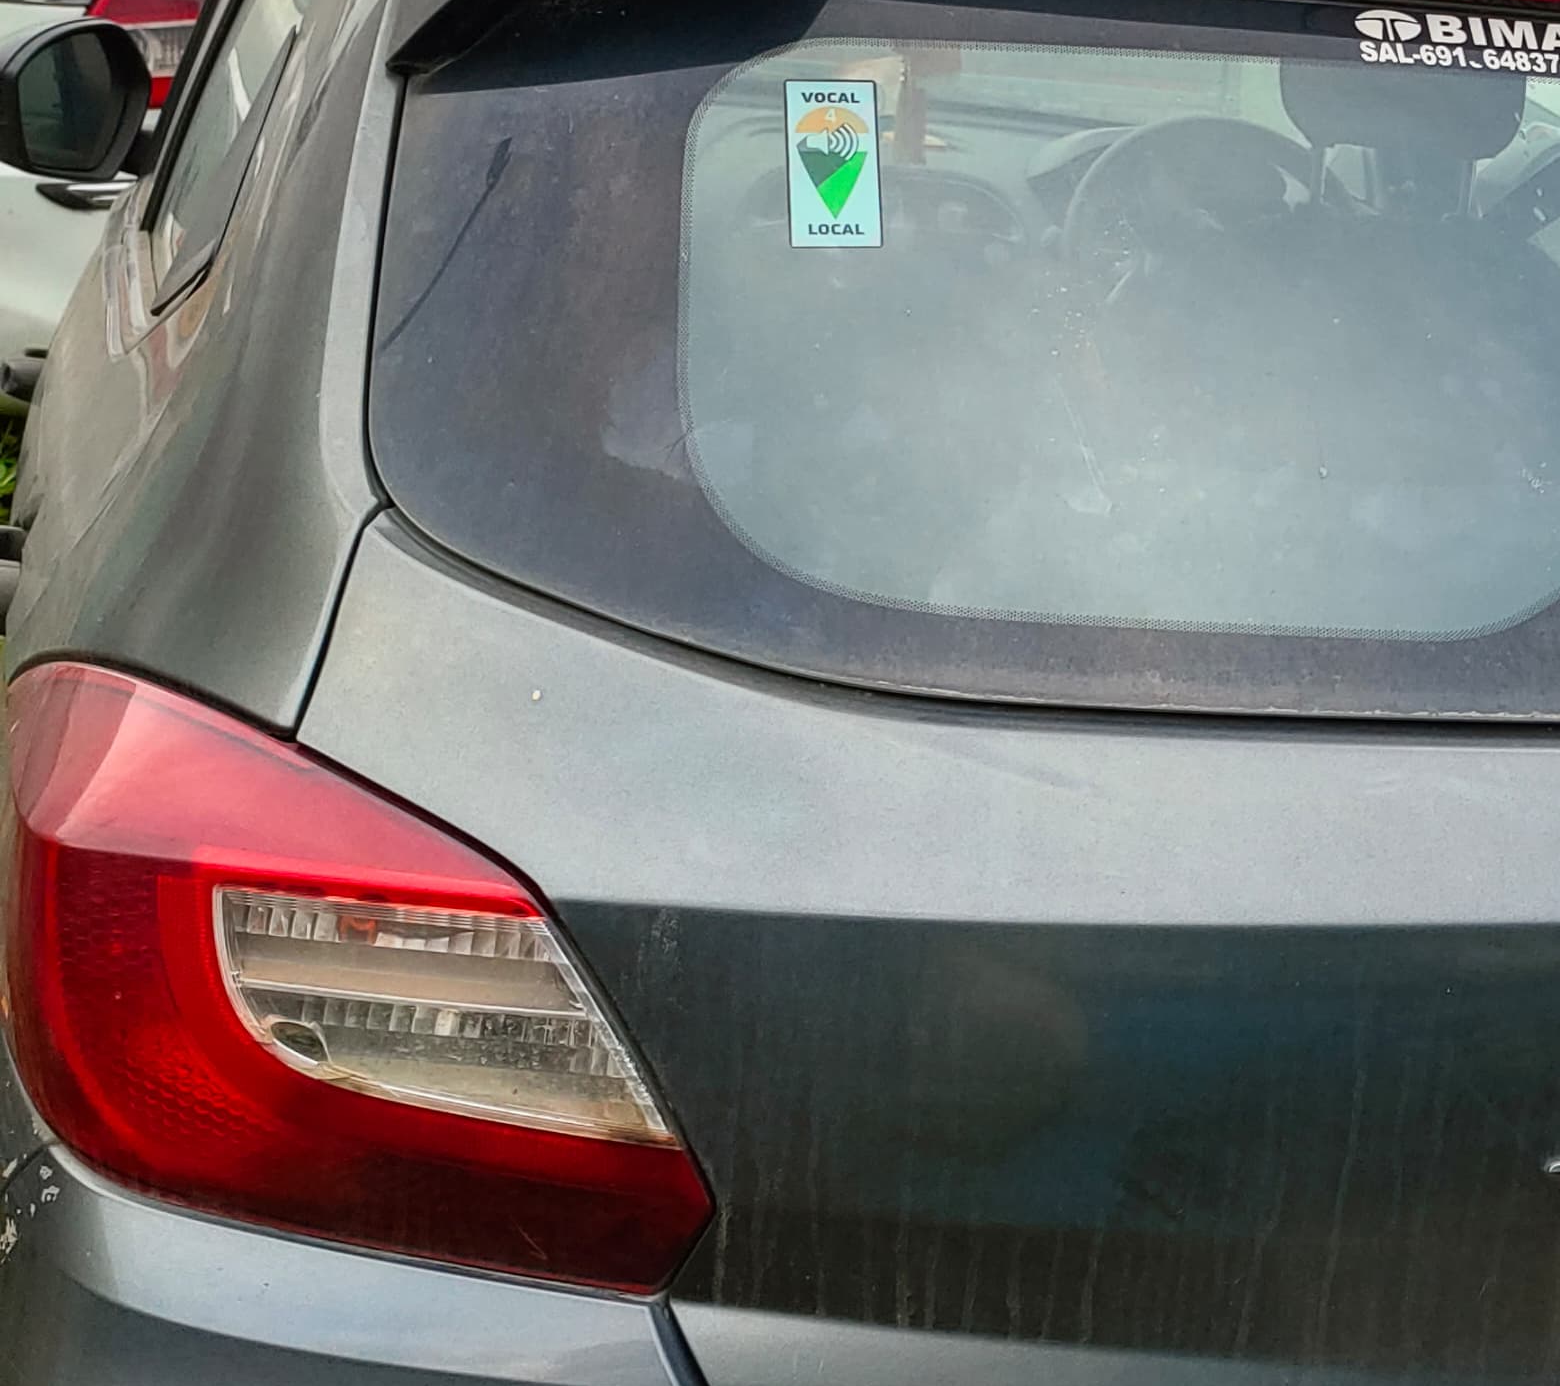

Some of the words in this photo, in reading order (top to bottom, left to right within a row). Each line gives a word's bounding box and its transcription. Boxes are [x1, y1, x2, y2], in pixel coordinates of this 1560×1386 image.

[801, 92, 861, 104] VOCAL
[824, 108, 837, 123] 4
[808, 223, 865, 236] LOCAL
